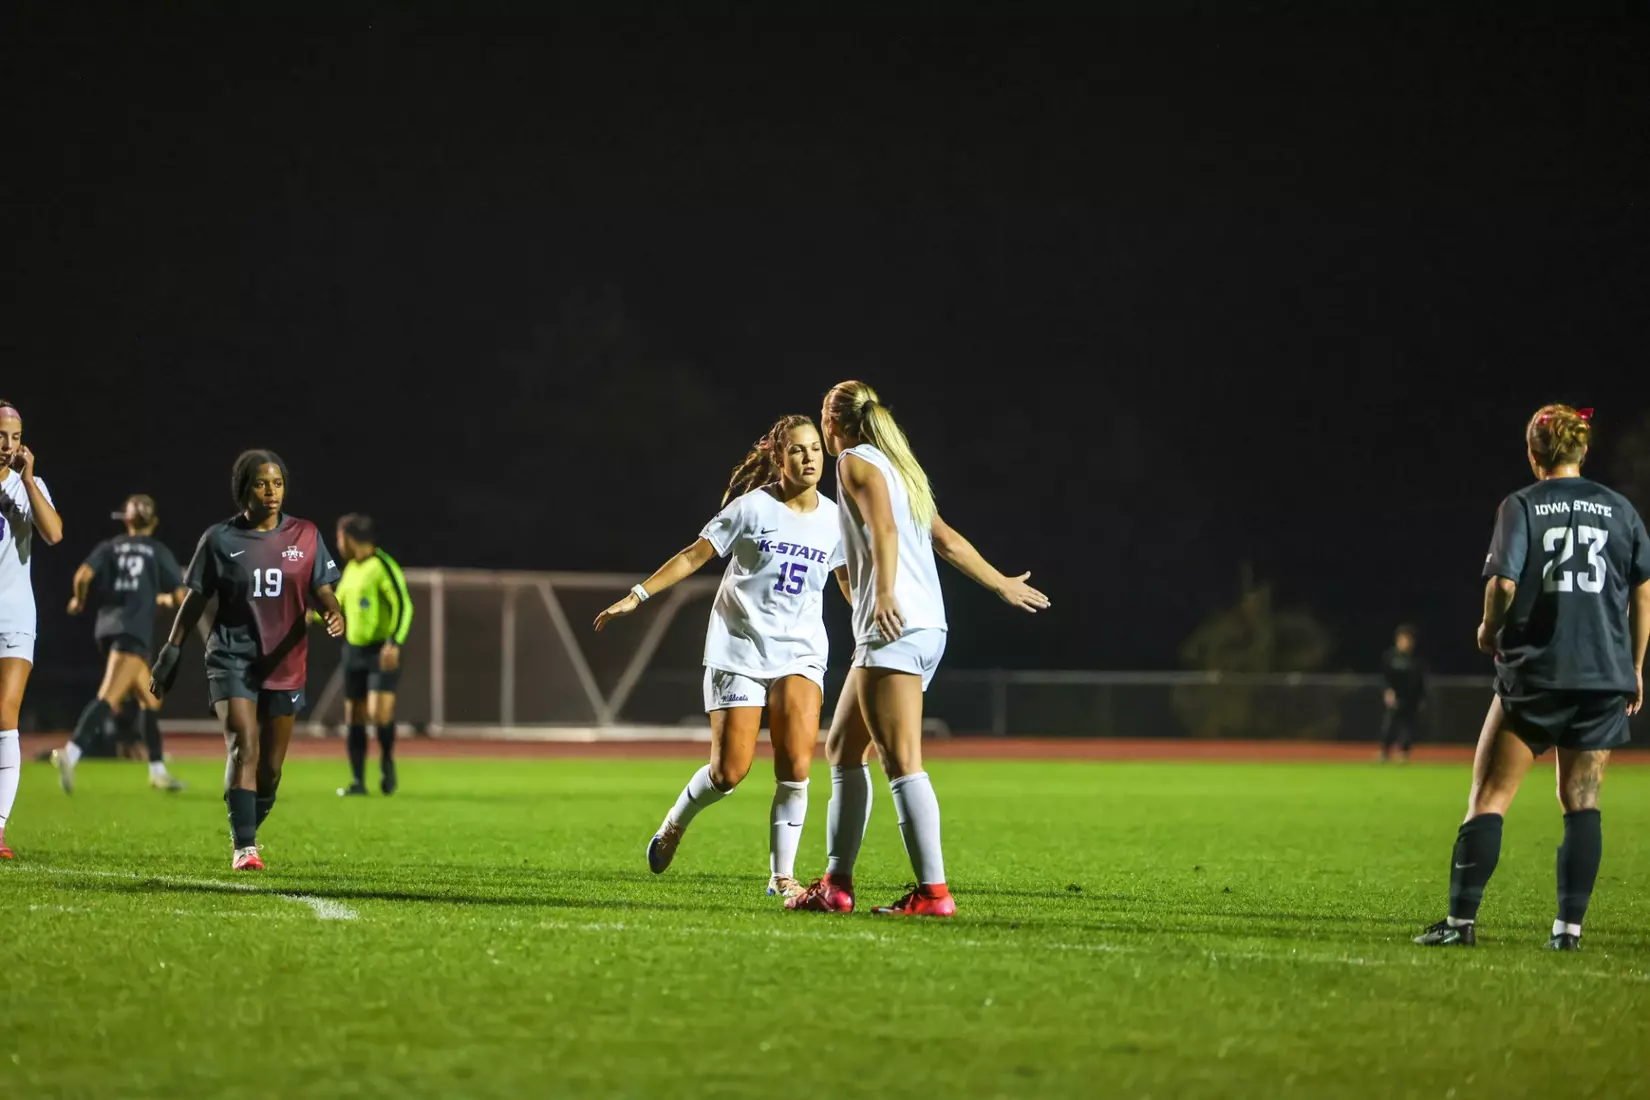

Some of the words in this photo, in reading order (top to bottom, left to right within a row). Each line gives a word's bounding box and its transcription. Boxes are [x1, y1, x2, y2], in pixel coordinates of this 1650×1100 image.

[1535, 502, 1570, 516] IOWA
[1573, 500, 1612, 517] STATE
[281, 549, 304, 558] STATE
[758, 539, 828, 564] K-STATE
[1542, 525, 1609, 594] 23
[253, 568, 283, 597] 19
[773, 561, 808, 595] 15
